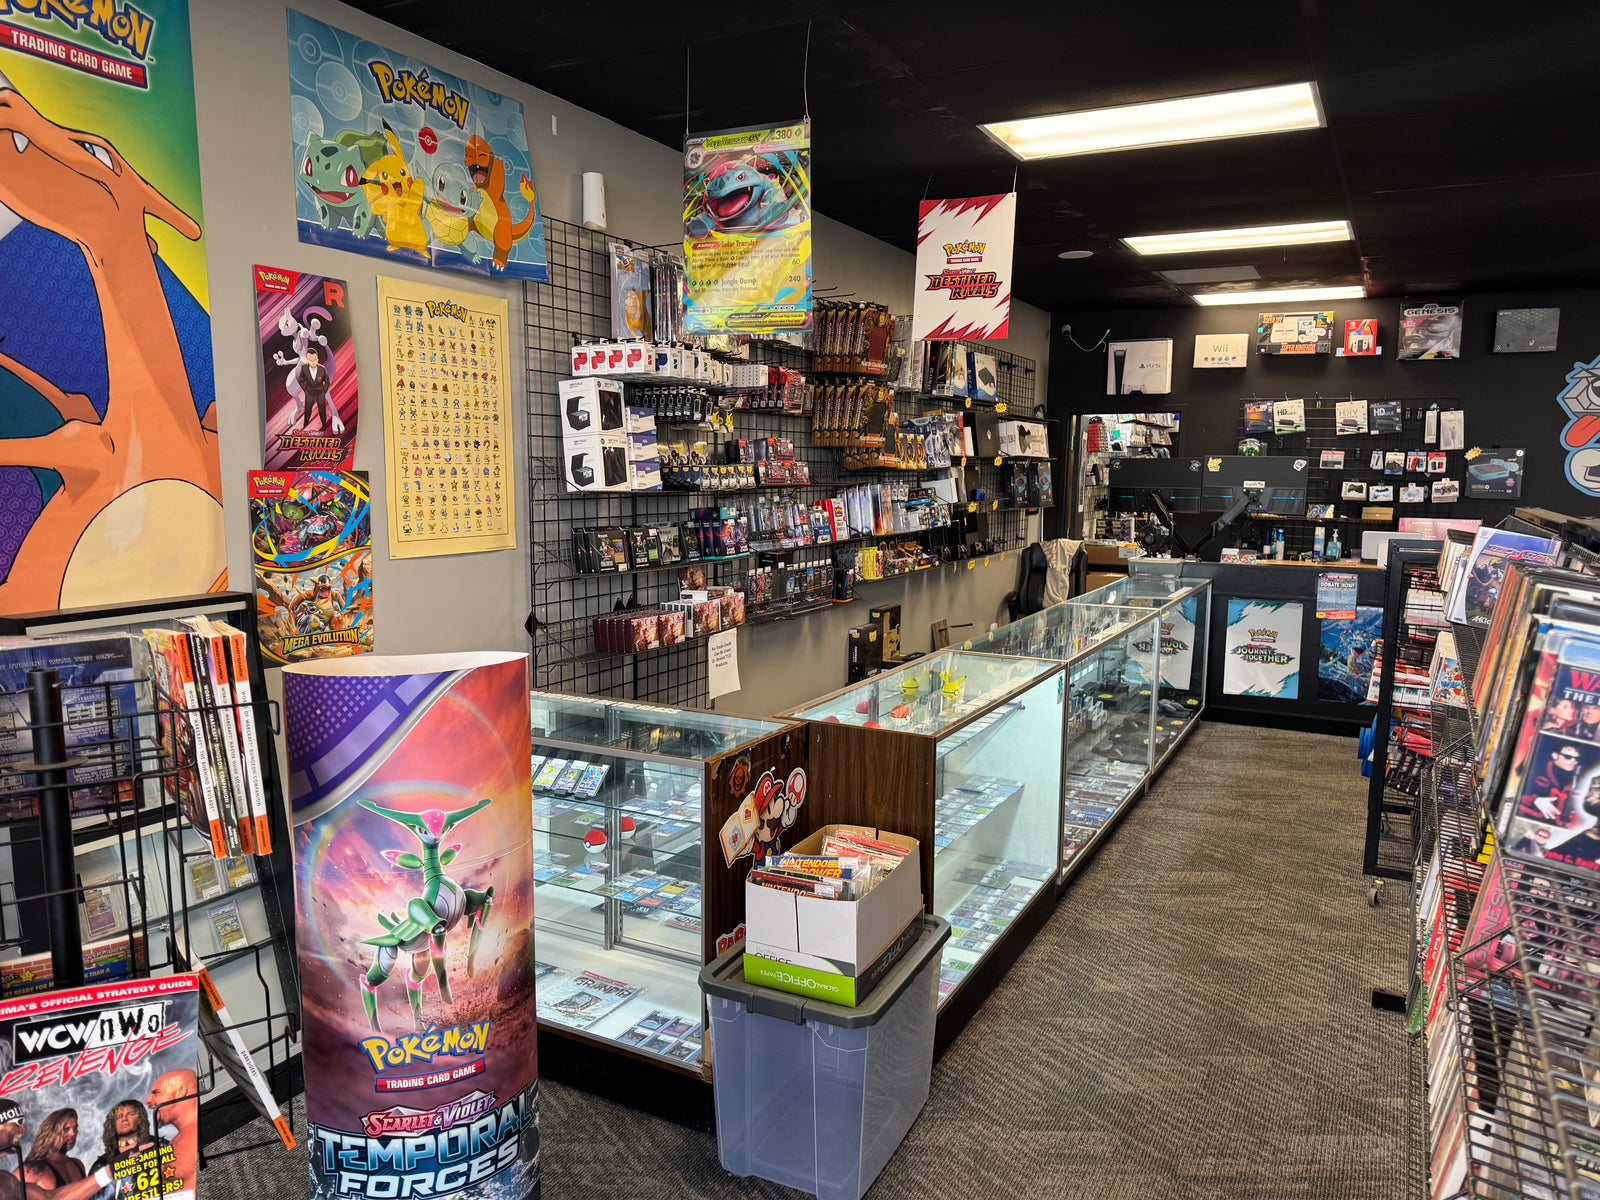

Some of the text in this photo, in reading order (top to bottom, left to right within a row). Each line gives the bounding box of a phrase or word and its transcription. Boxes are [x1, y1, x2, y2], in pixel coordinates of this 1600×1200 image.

[11, 30, 133, 79] TRADING CARD GAME
[775, 128, 793, 140] 380
[931, 274, 996, 289] DESTINED
[324, 281, 345, 308] R
[951, 285, 998, 299] RIVALS
[1213, 344, 1229, 353] Wii
[1277, 408, 1288, 416] HD
[1373, 408, 1385, 416] HD
[282, 437, 341, 449] DESTINED
[302, 448, 342, 461] RIVALS
[282, 629, 359, 654] MEGA EVOLUTION
[1236, 646, 1272, 655] JOURNEY
[1246, 654, 1289, 665] TOGETHER
[1563, 690, 1595, 704] THE
[203, 684, 212, 704] WORLD
[214, 743, 224, 773] DUNGEON
[219, 773, 229, 803] COMPANION
[248, 748, 257, 775] DUNGEON
[251, 775, 262, 807] COMPANION
[782, 859, 828, 867] NINTENDO
[89, 969, 105, 978] THAN
[776, 971, 817, 989] OFFICE
[41, 994, 94, 1008] OFFICIAL
[96, 985, 156, 999] STRATEGY
[158, 980, 193, 991] GUIDE
[816, 982, 839, 993] GLOBAL
[0, 1023, 193, 1095] REVENGE
[386, 1064, 476, 1089] TRADING CARD GAME
[316, 1089, 534, 1172] TEMPORAL
[114, 1165, 142, 1180] MOVES
[161, 1153, 177, 1164] ALL
[340, 1136, 519, 1199] FORCES
[137, 1168, 160, 1190] 62
[124, 1179, 184, 1200] RESTLRS!
